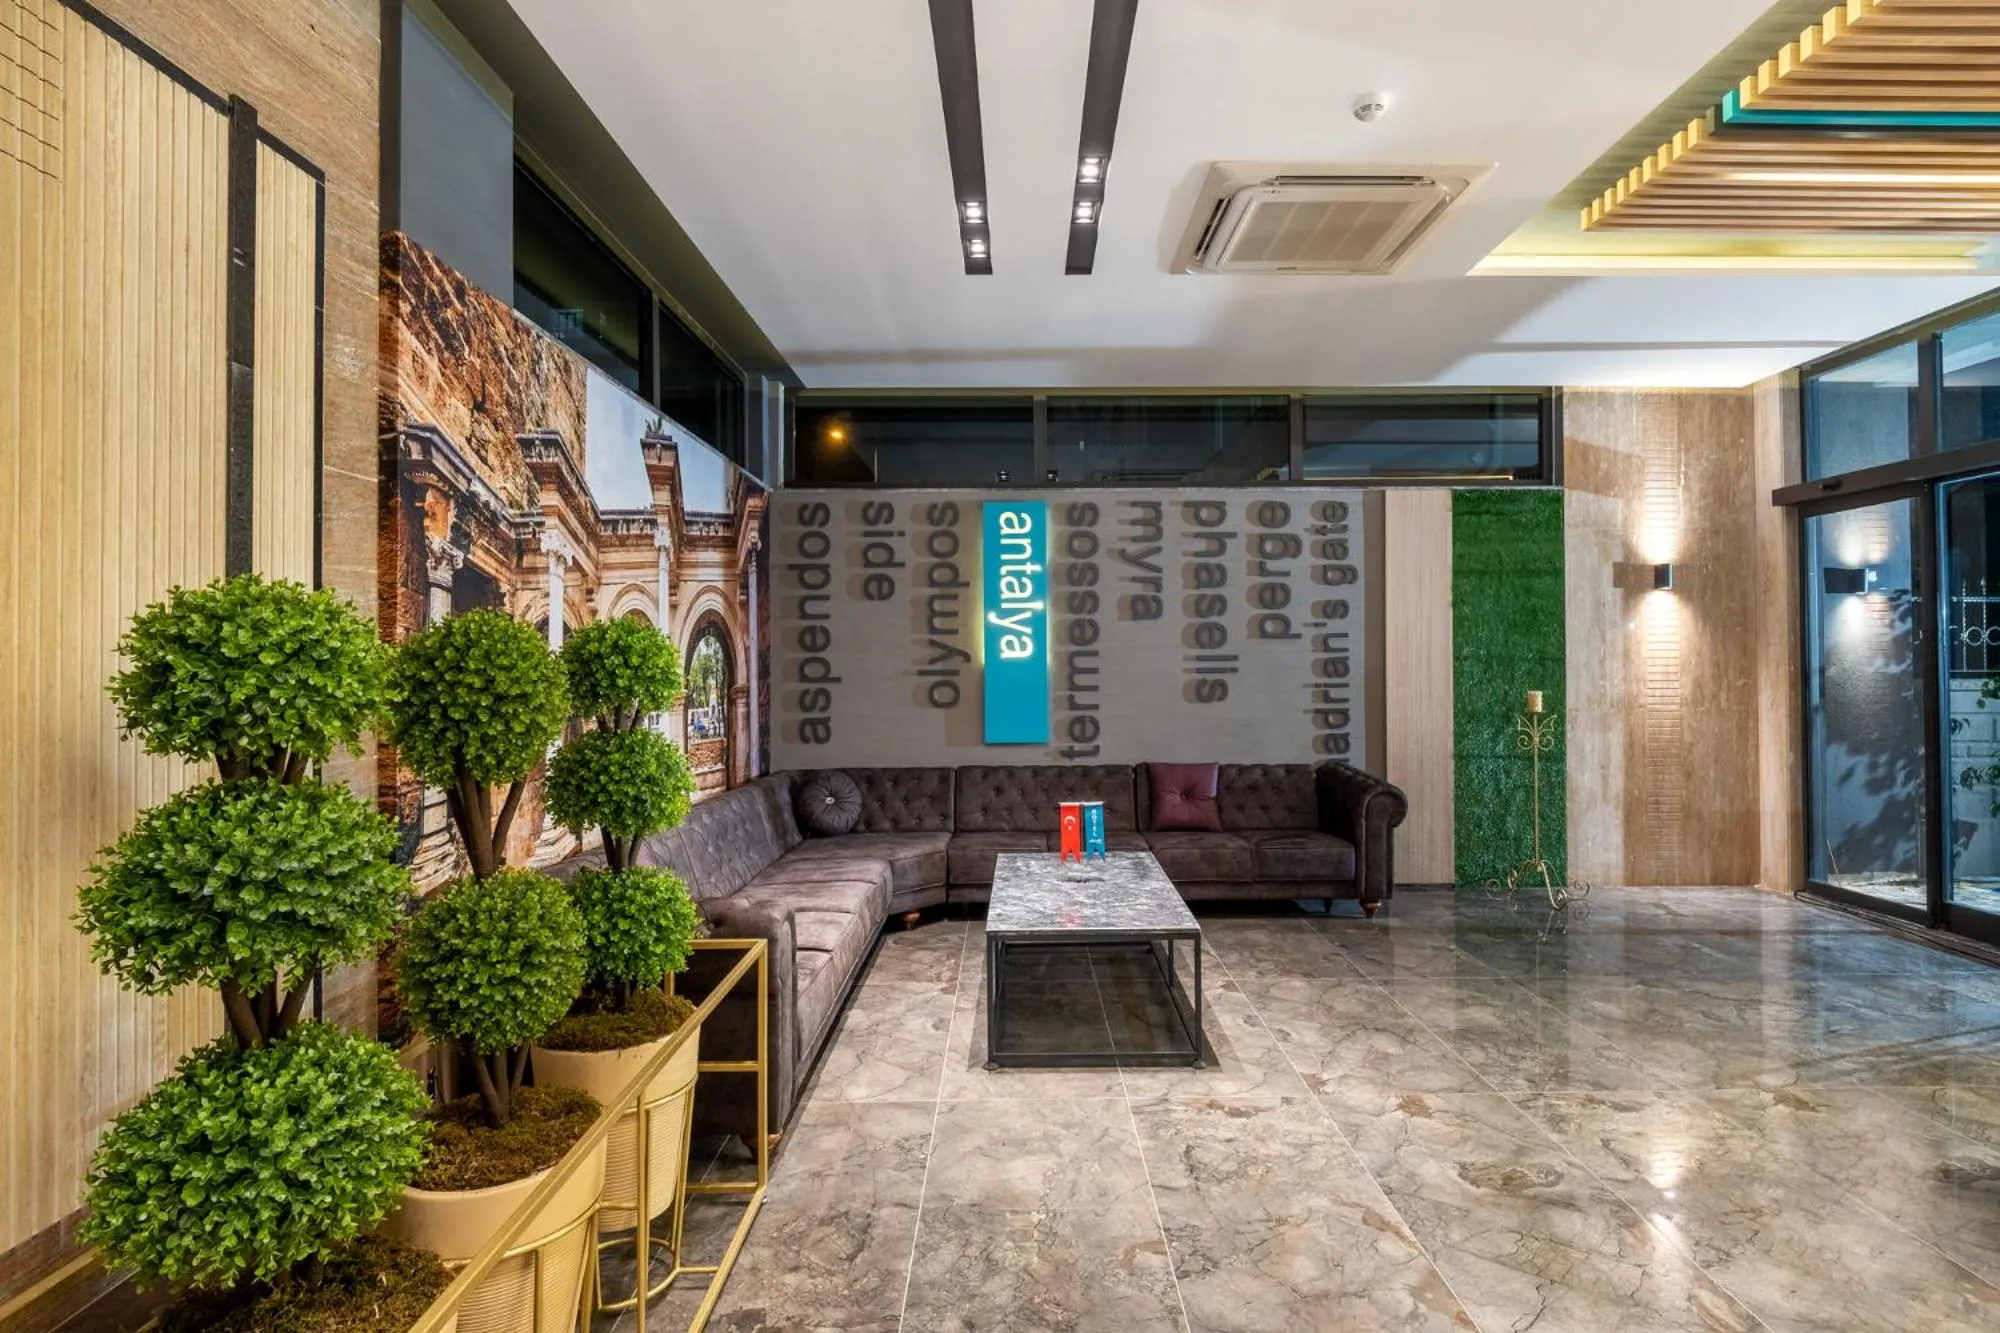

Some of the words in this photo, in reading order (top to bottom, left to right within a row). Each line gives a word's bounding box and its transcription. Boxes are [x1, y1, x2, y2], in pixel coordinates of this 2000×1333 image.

[862, 501, 906, 601] side
[918, 502, 971, 709] olympos
[987, 511, 1044, 660] antalya
[1119, 501, 1164, 621] myra
[1182, 501, 1239, 704] phaselis
[1258, 501, 1303, 640] perge
[1312, 501, 1359, 587] gate
[787, 502, 842, 745] aspendos
[1060, 502, 1100, 761] termessos
